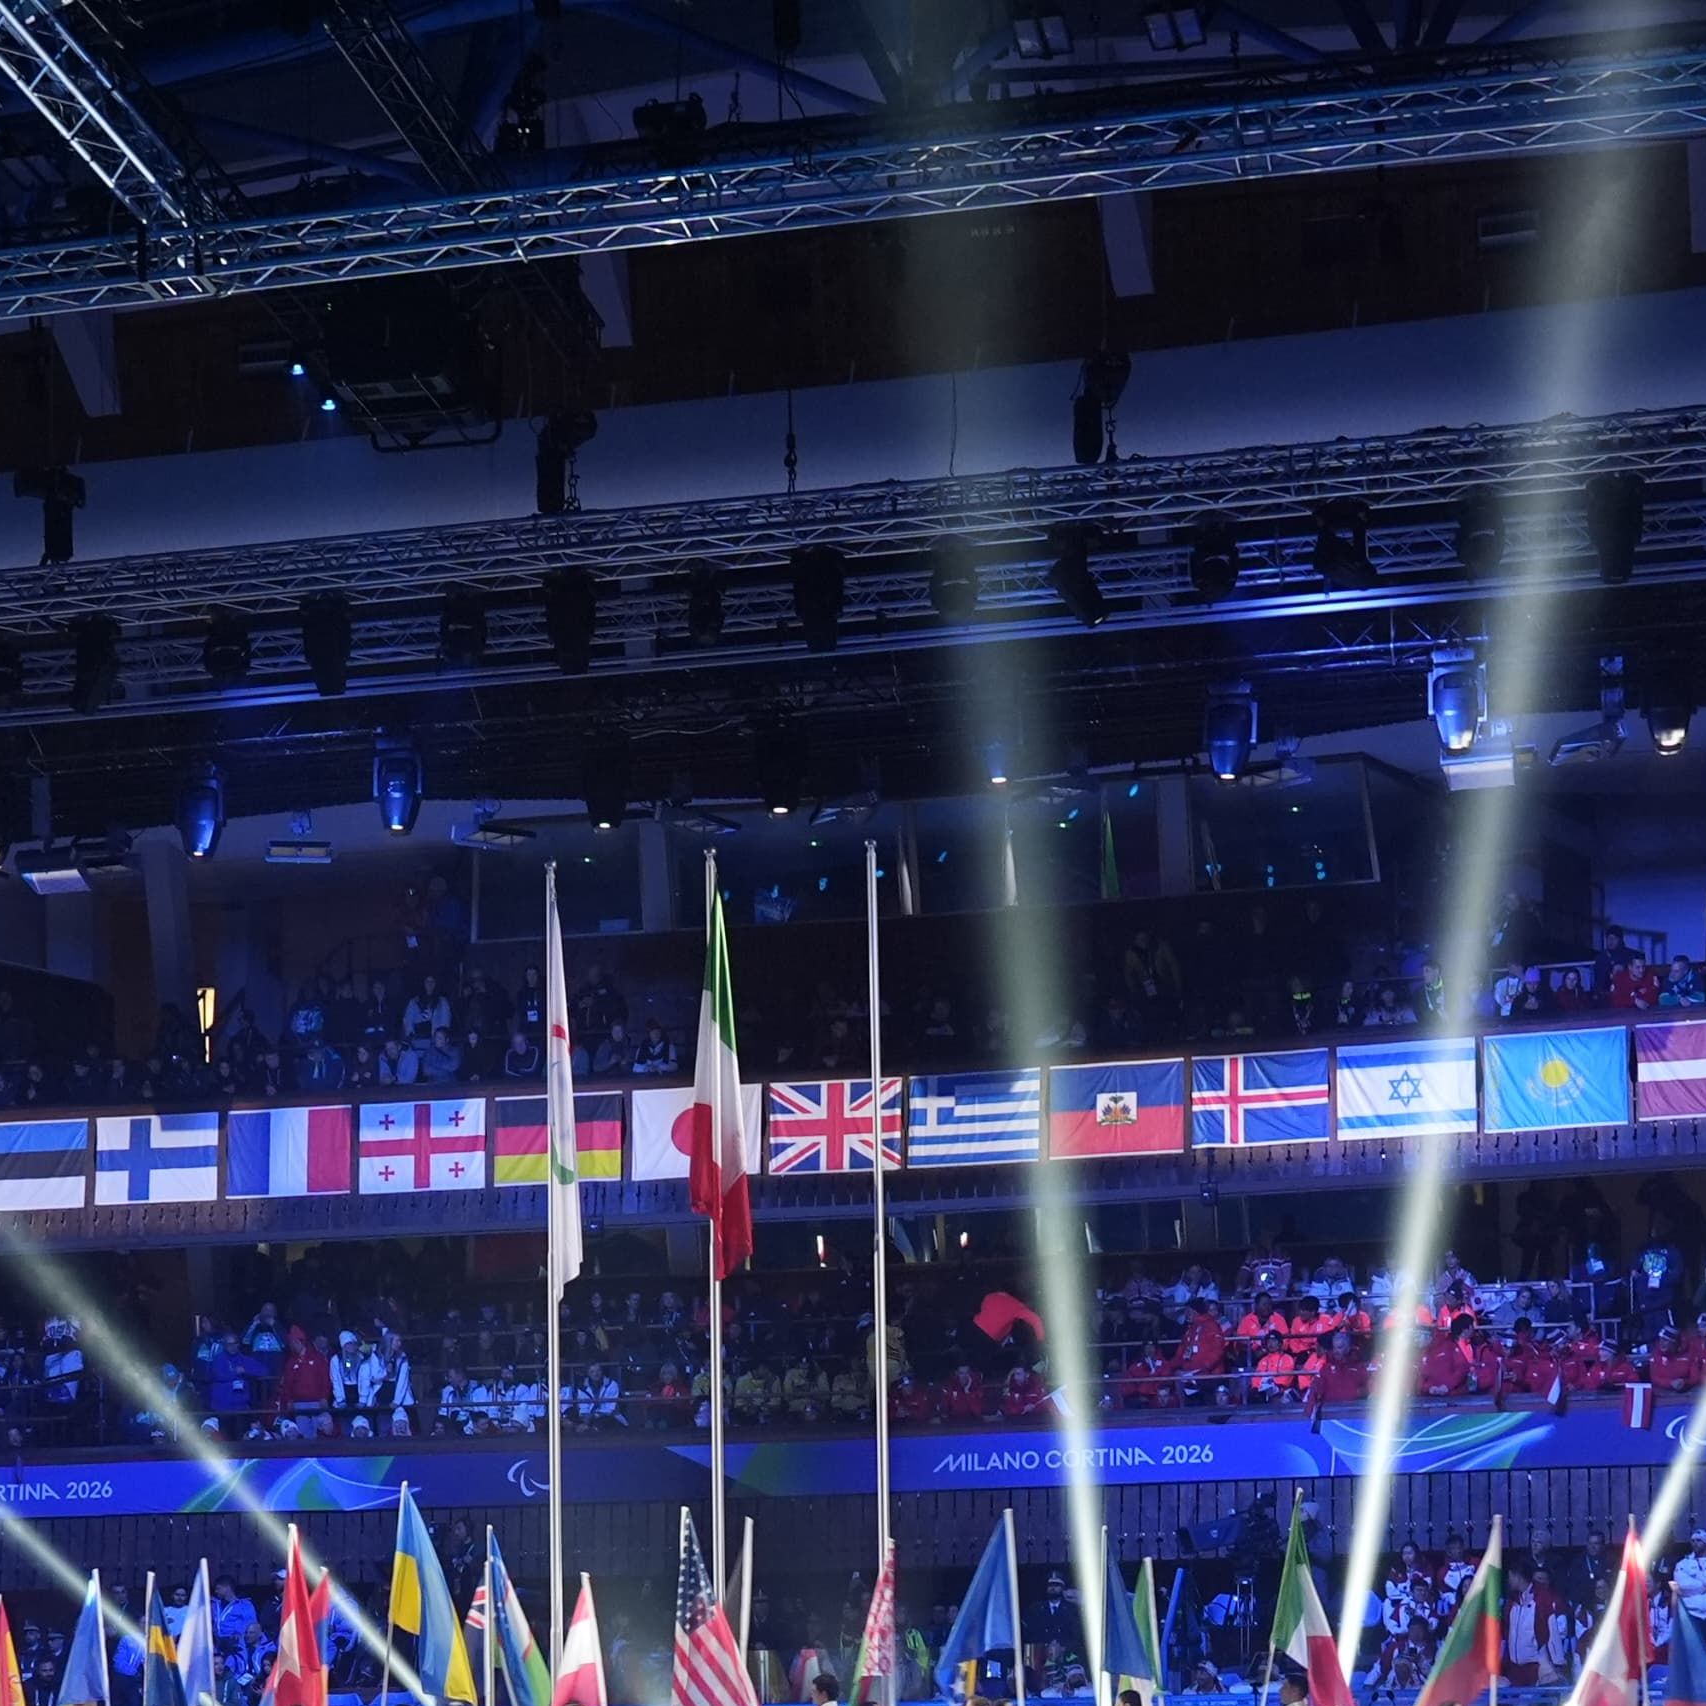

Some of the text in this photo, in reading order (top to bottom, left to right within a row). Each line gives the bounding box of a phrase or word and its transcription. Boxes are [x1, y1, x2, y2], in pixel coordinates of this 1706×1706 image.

[933, 1444, 1214, 1472] MILANO CORTINA 2026
[66, 1480, 113, 1499] 2026
